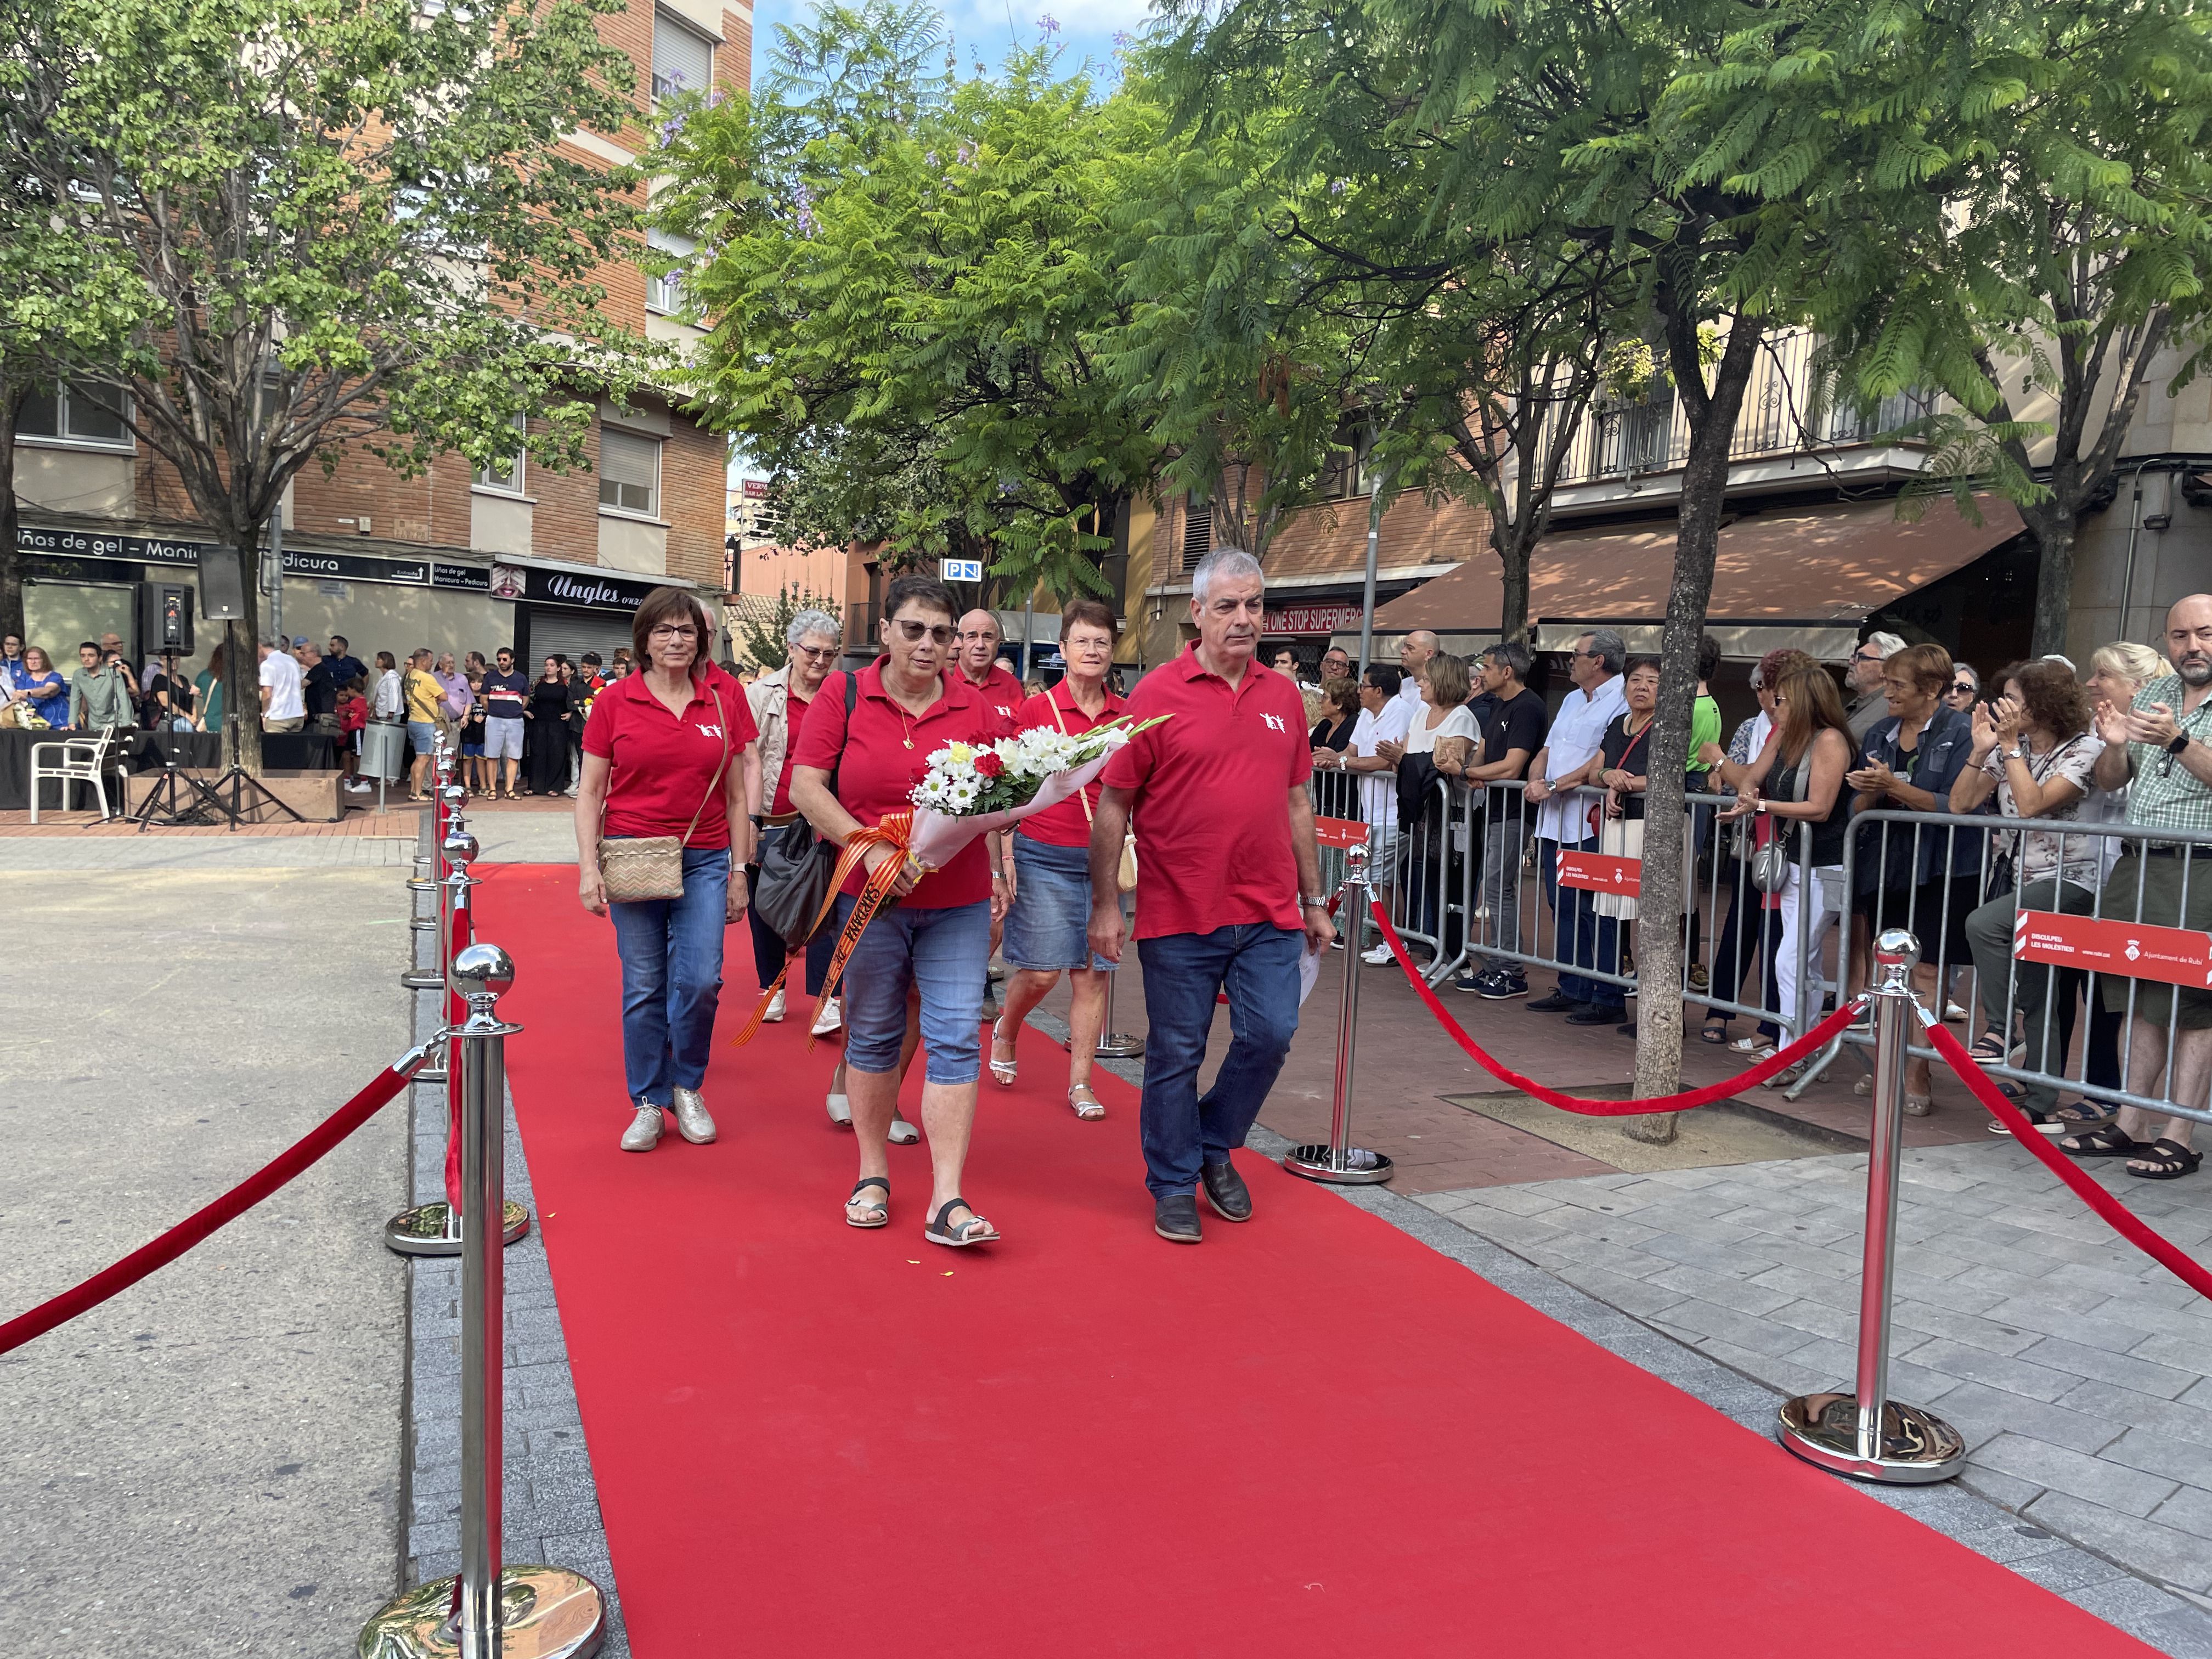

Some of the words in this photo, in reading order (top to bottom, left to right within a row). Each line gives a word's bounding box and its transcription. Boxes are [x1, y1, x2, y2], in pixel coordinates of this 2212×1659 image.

[62, 534, 87, 549] de
[93, 538, 122, 555] gel
[283, 552, 338, 571] dicura
[435, 566, 448, 574] Uñas
[435, 575, 460, 584] Manicura
[465, 578, 488, 586] Pedicura
[548, 574, 620, 605] Ungles
[1271, 610, 1286, 630] ONE
[1288, 609, 1309, 630] STOP
[844, 882, 881, 944] SARDANA
[2032, 933, 2063, 943] DISCULPEU
[2042, 941, 2075, 952] MOLÈSTIES!
[833, 945, 848, 970] DE
[2144, 951, 2178, 962] Ajuntament
[2188, 957, 2203, 966] Rubí
